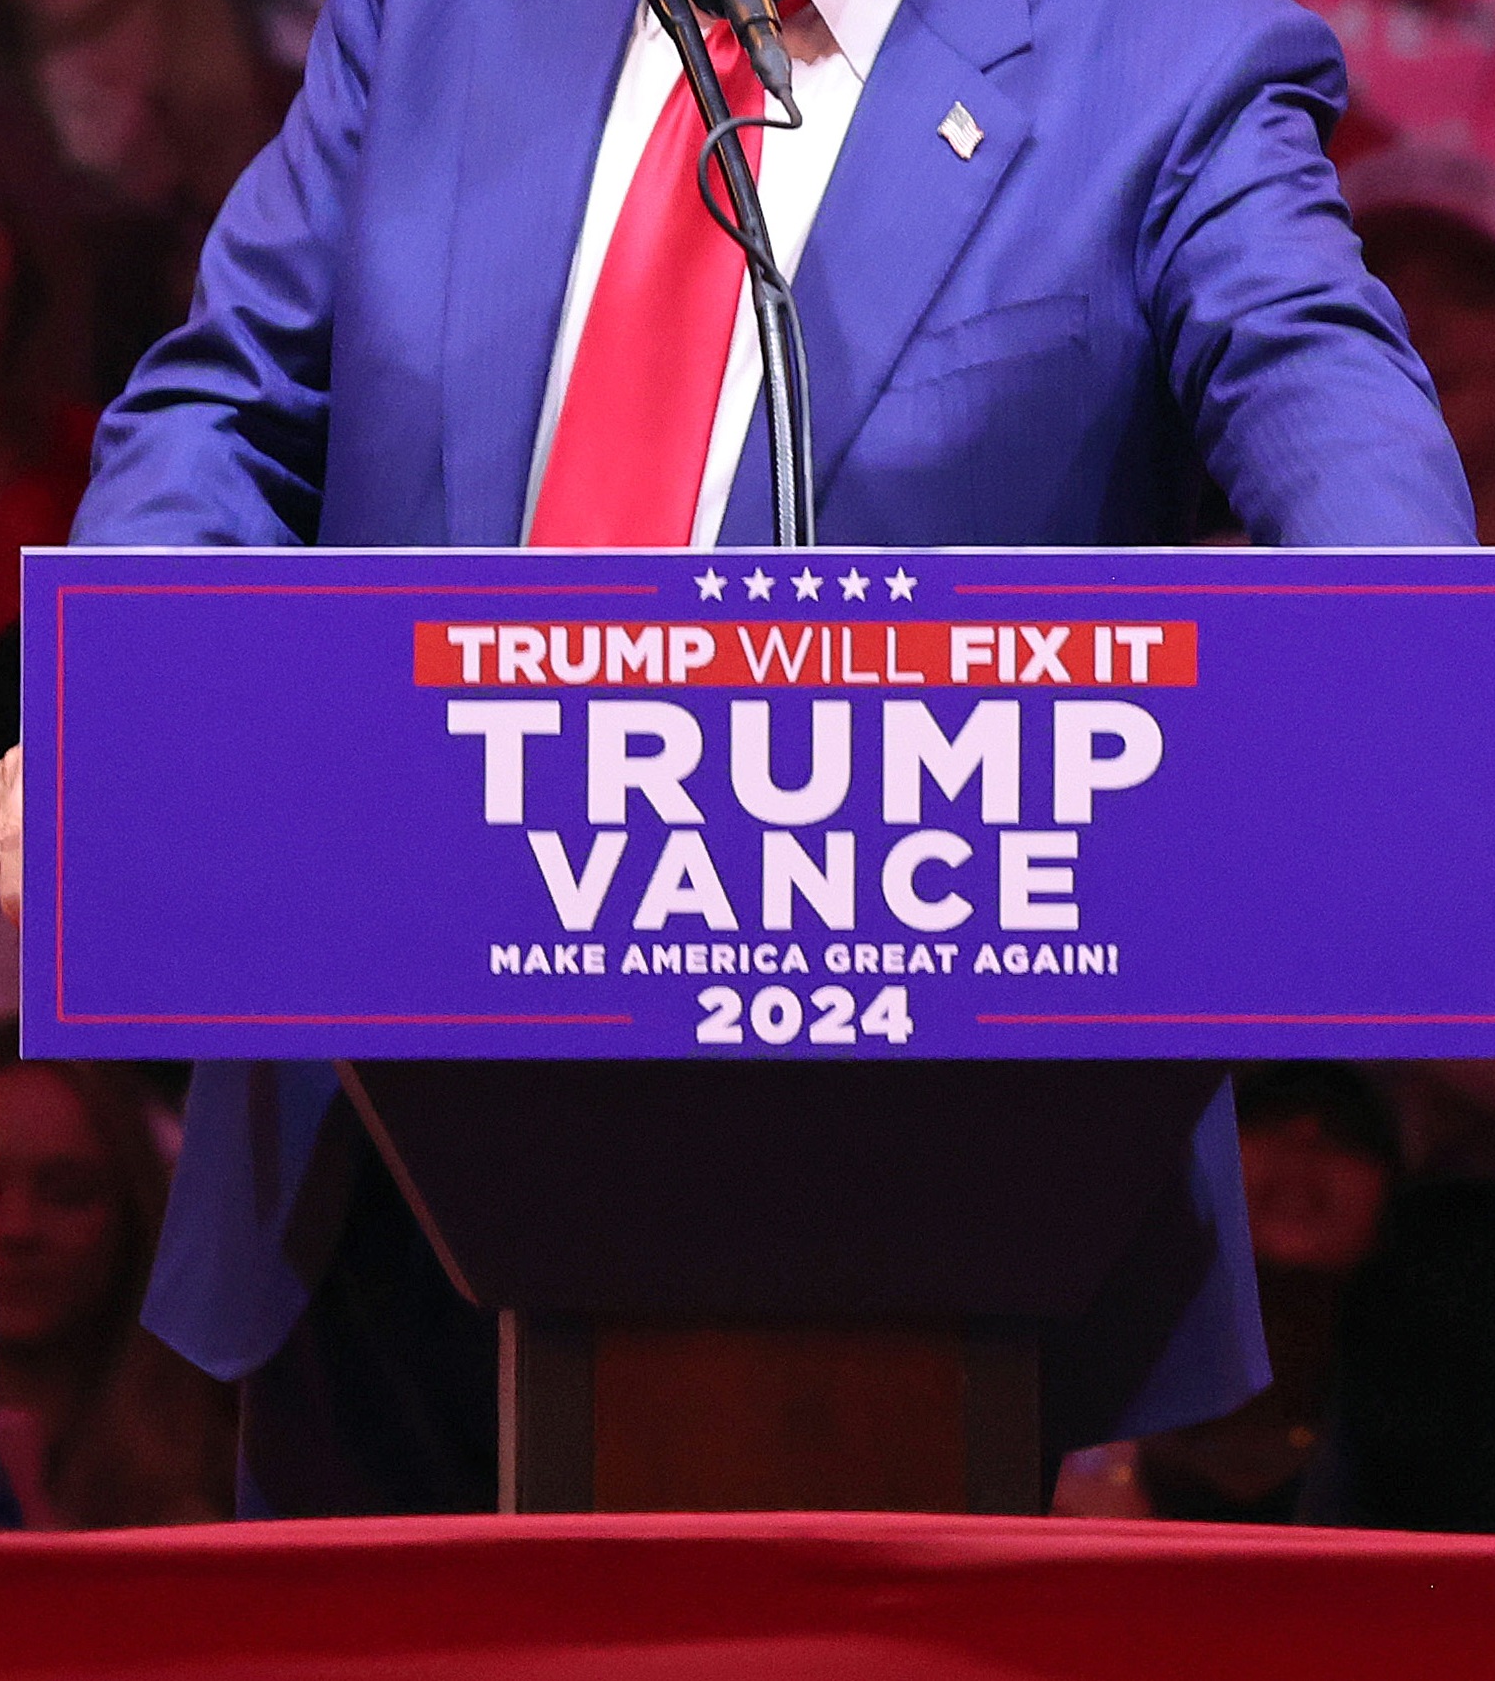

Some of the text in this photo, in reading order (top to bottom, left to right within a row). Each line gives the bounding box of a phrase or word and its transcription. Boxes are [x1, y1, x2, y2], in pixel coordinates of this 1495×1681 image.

[447, 625, 1164, 684] TRUMP WILL FIX IT
[447, 699, 1164, 826] TRUMP
[526, 829, 1080, 932] VANCE
[490, 942, 1118, 975] MAKE AMERICA GREAT AGAIN!
[695, 984, 915, 1045] 2024
